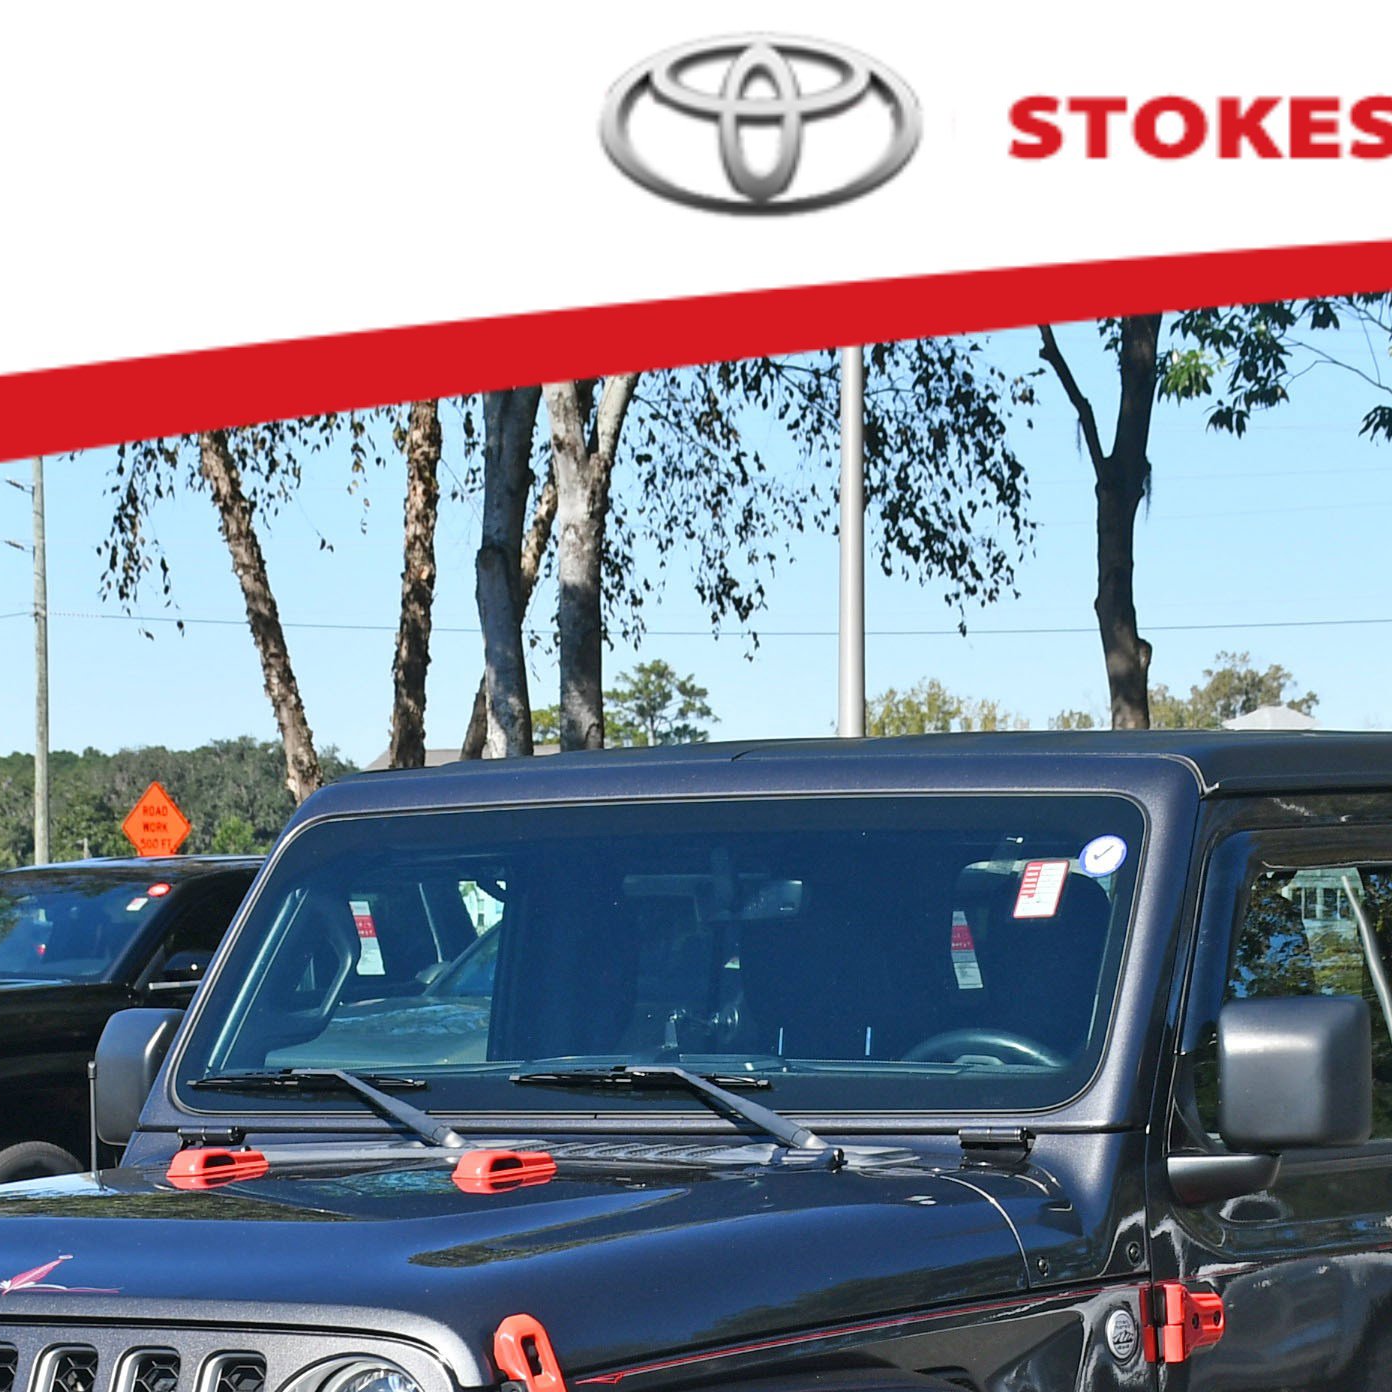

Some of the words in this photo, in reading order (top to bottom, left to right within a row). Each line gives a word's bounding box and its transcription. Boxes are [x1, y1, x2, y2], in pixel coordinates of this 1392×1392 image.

[142, 805, 168, 817] ROAD
[143, 822, 168, 833] WORK
[161, 839, 171, 849] FT
